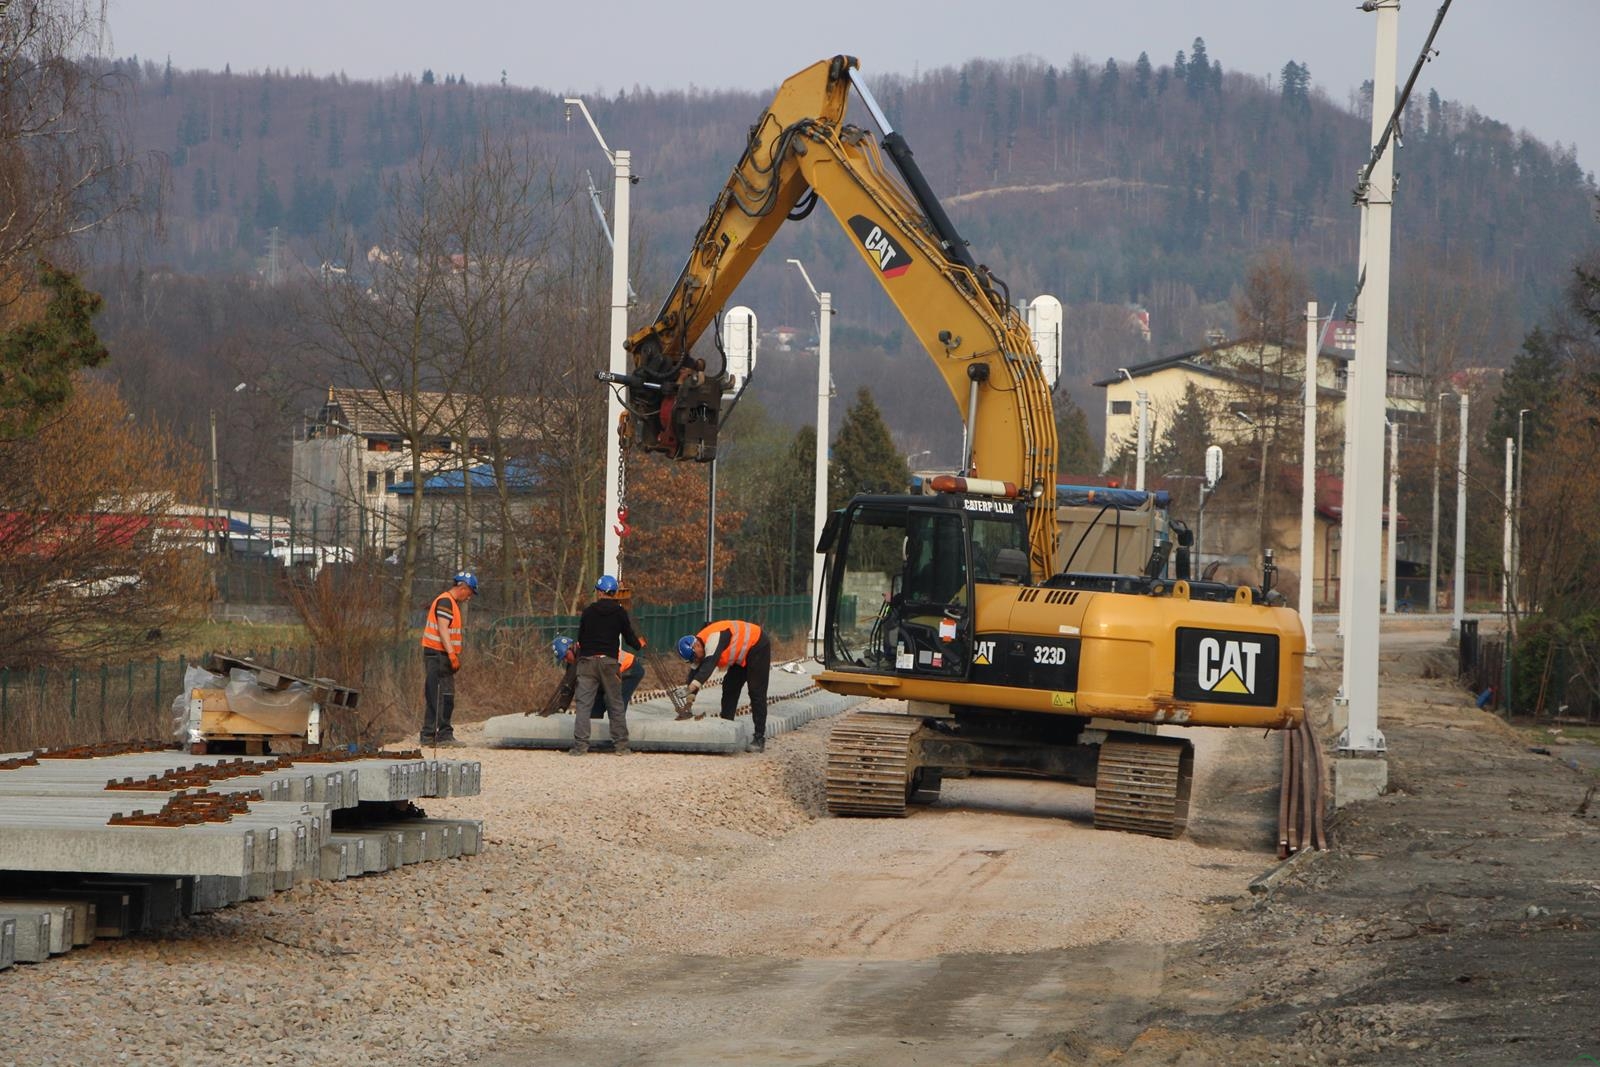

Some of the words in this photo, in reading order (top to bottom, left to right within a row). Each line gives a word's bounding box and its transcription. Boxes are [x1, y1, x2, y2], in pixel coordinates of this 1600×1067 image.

[865, 226, 896, 271] CAT
[1033, 645, 1066, 665] 323D
[1198, 637, 1261, 695] CAT
